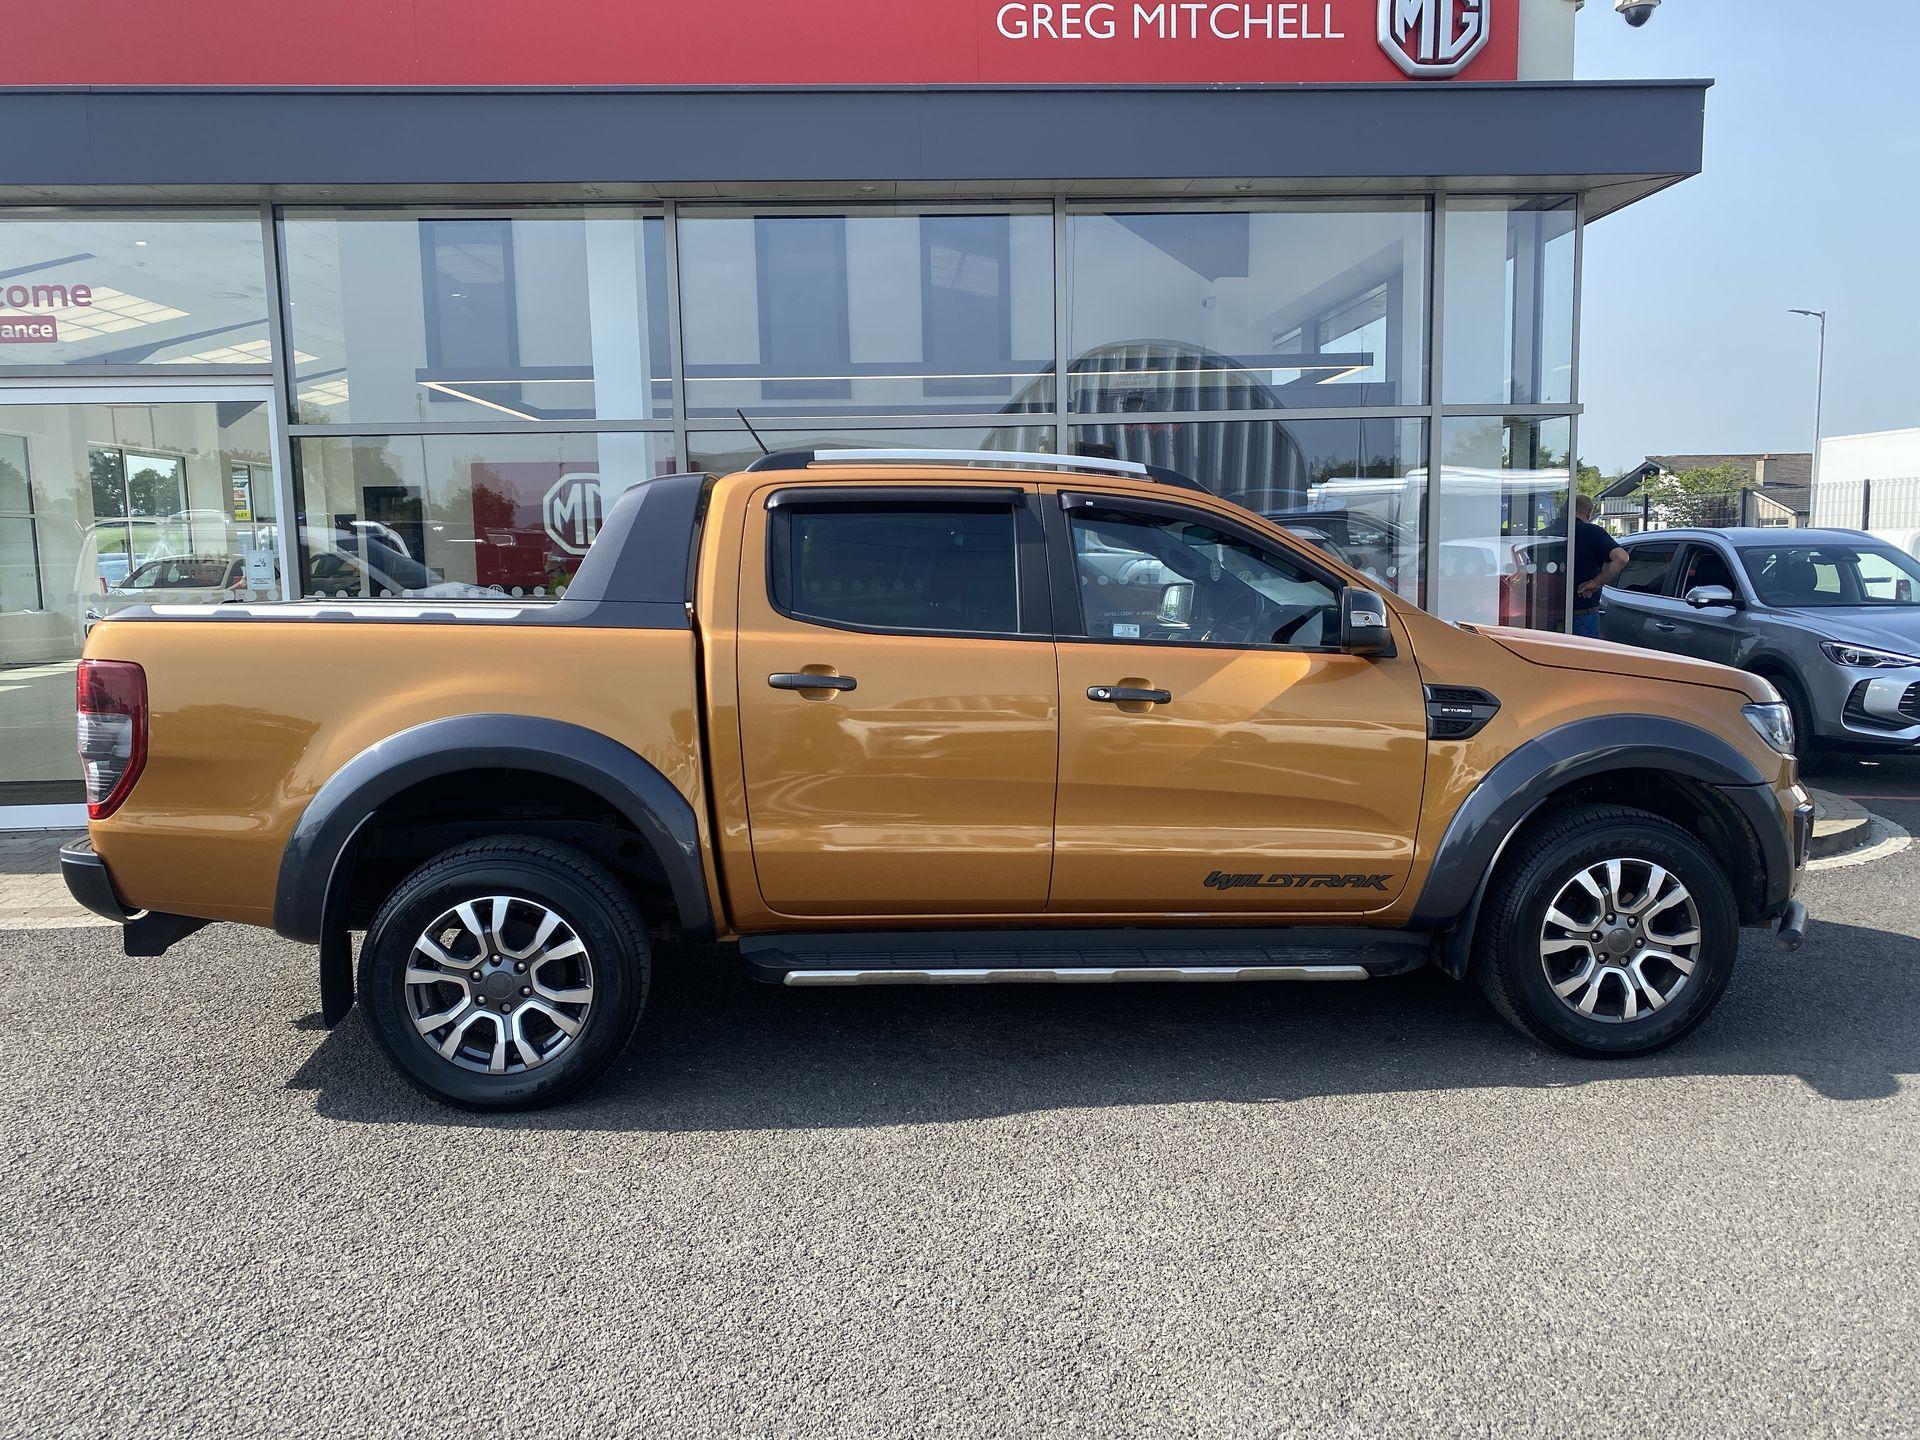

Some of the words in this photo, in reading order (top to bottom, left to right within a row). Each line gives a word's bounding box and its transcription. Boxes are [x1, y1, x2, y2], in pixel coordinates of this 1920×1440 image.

[996, 2, 1116, 40] GREG
[1134, 2, 1345, 40] MITCHELL
[0, 284, 93, 309] ome
[0, 323, 57, 339] ance
[1203, 870, 1396, 891] WILDTRAK
